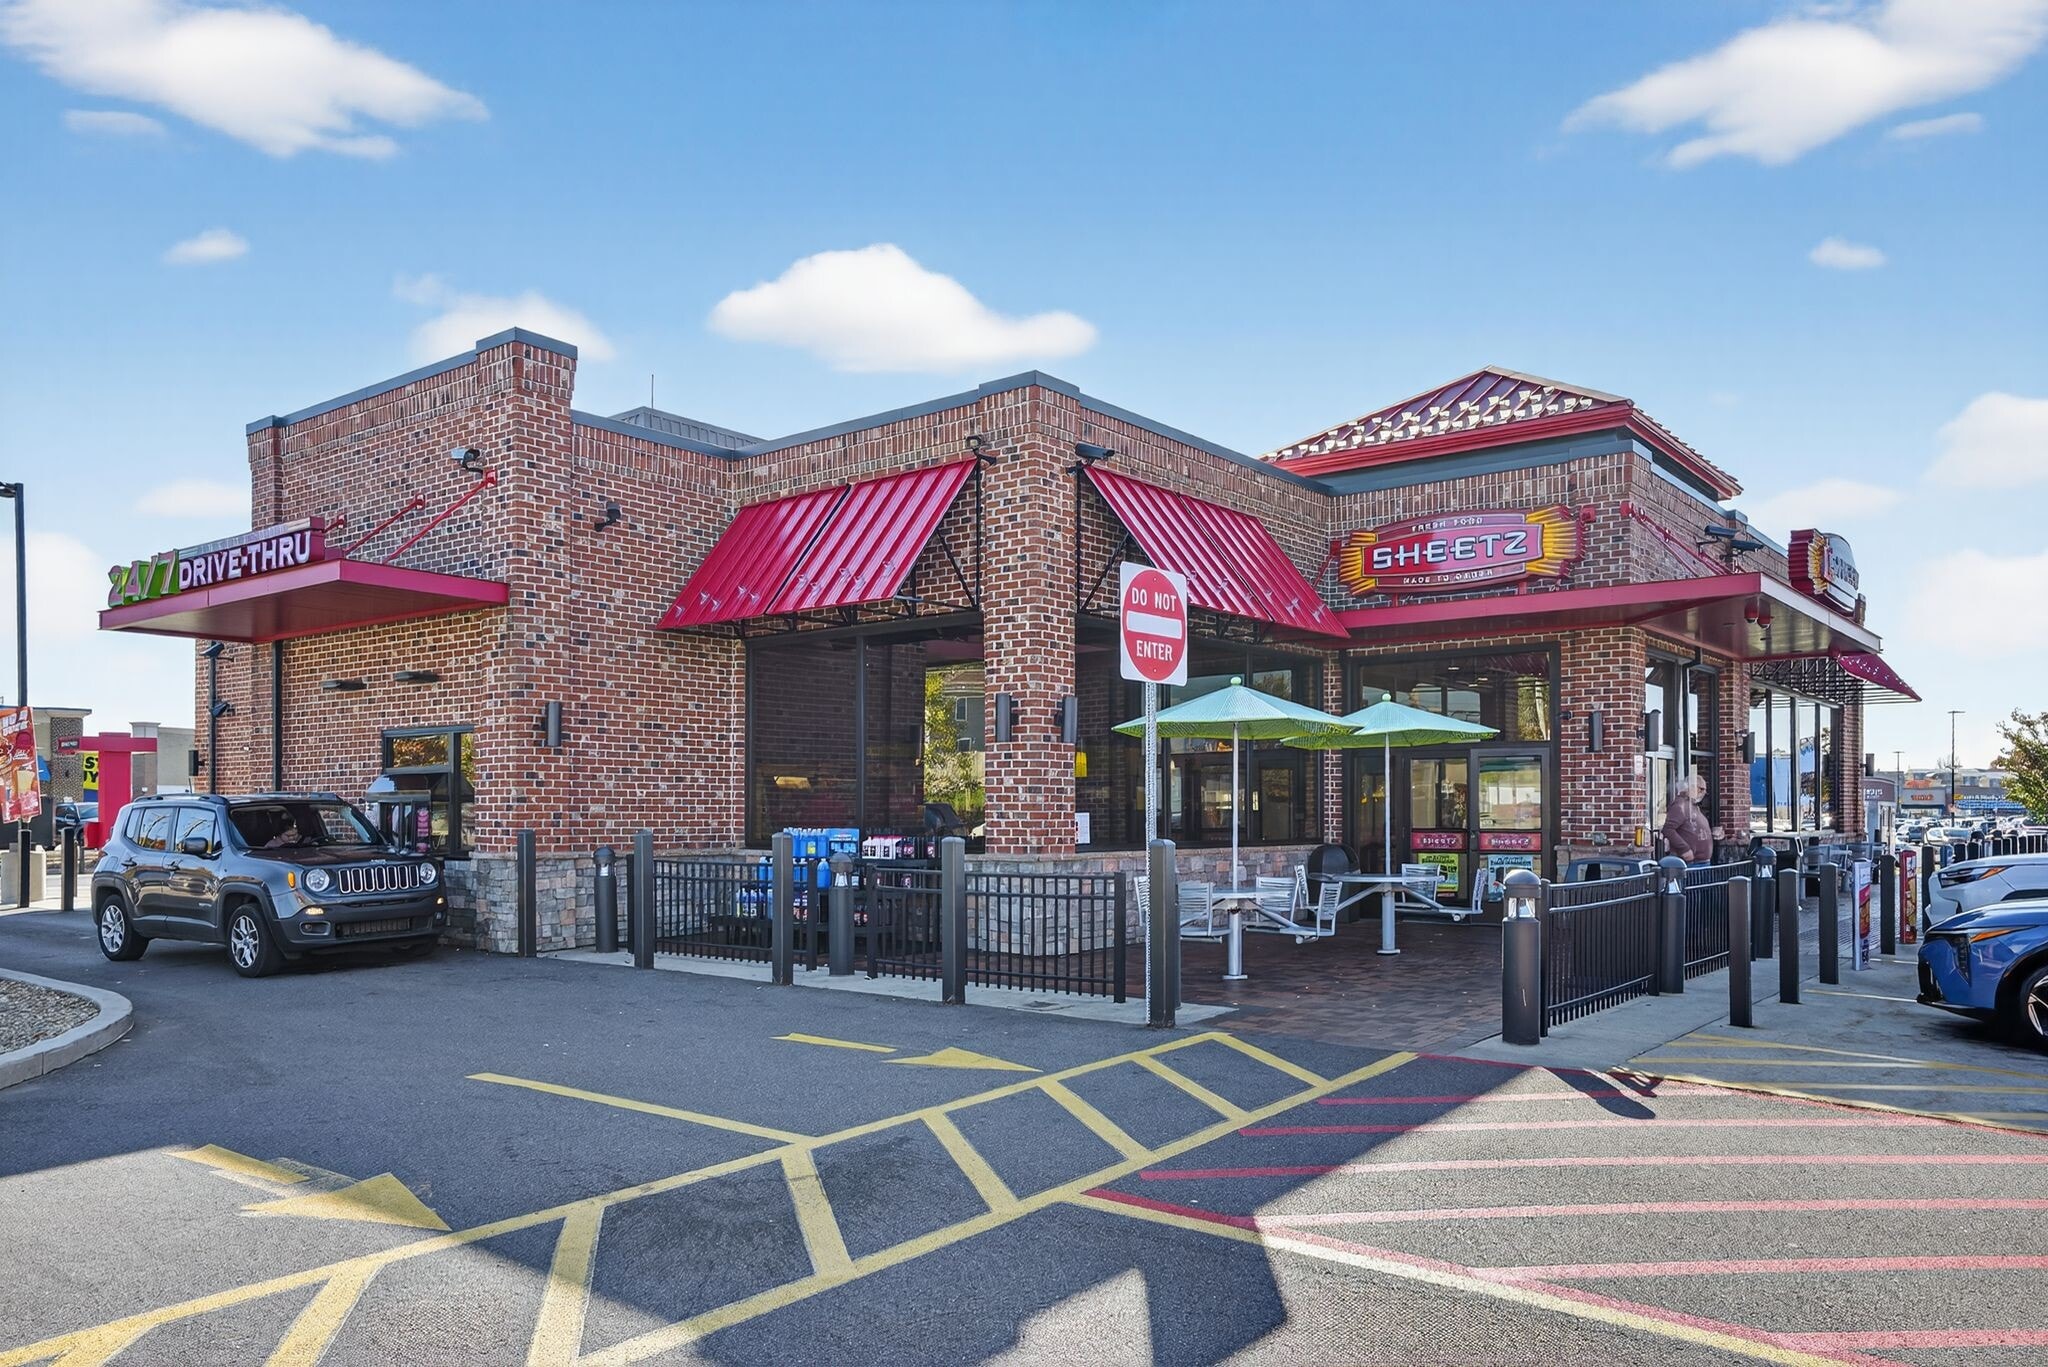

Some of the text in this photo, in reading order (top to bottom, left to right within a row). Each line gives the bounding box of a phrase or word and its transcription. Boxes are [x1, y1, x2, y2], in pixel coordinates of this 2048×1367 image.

[1411, 516, 1484, 532] FRESH FOOD
[1372, 530, 1528, 570] SHEETZ
[108, 531, 311, 607] 24/7 DRIVE-THRU
[1402, 576, 1431, 584] MADE
[1437, 575, 1450, 583] TO
[1131, 587, 1177, 612] DO NOT
[1136, 639, 1173, 662] ENTER
